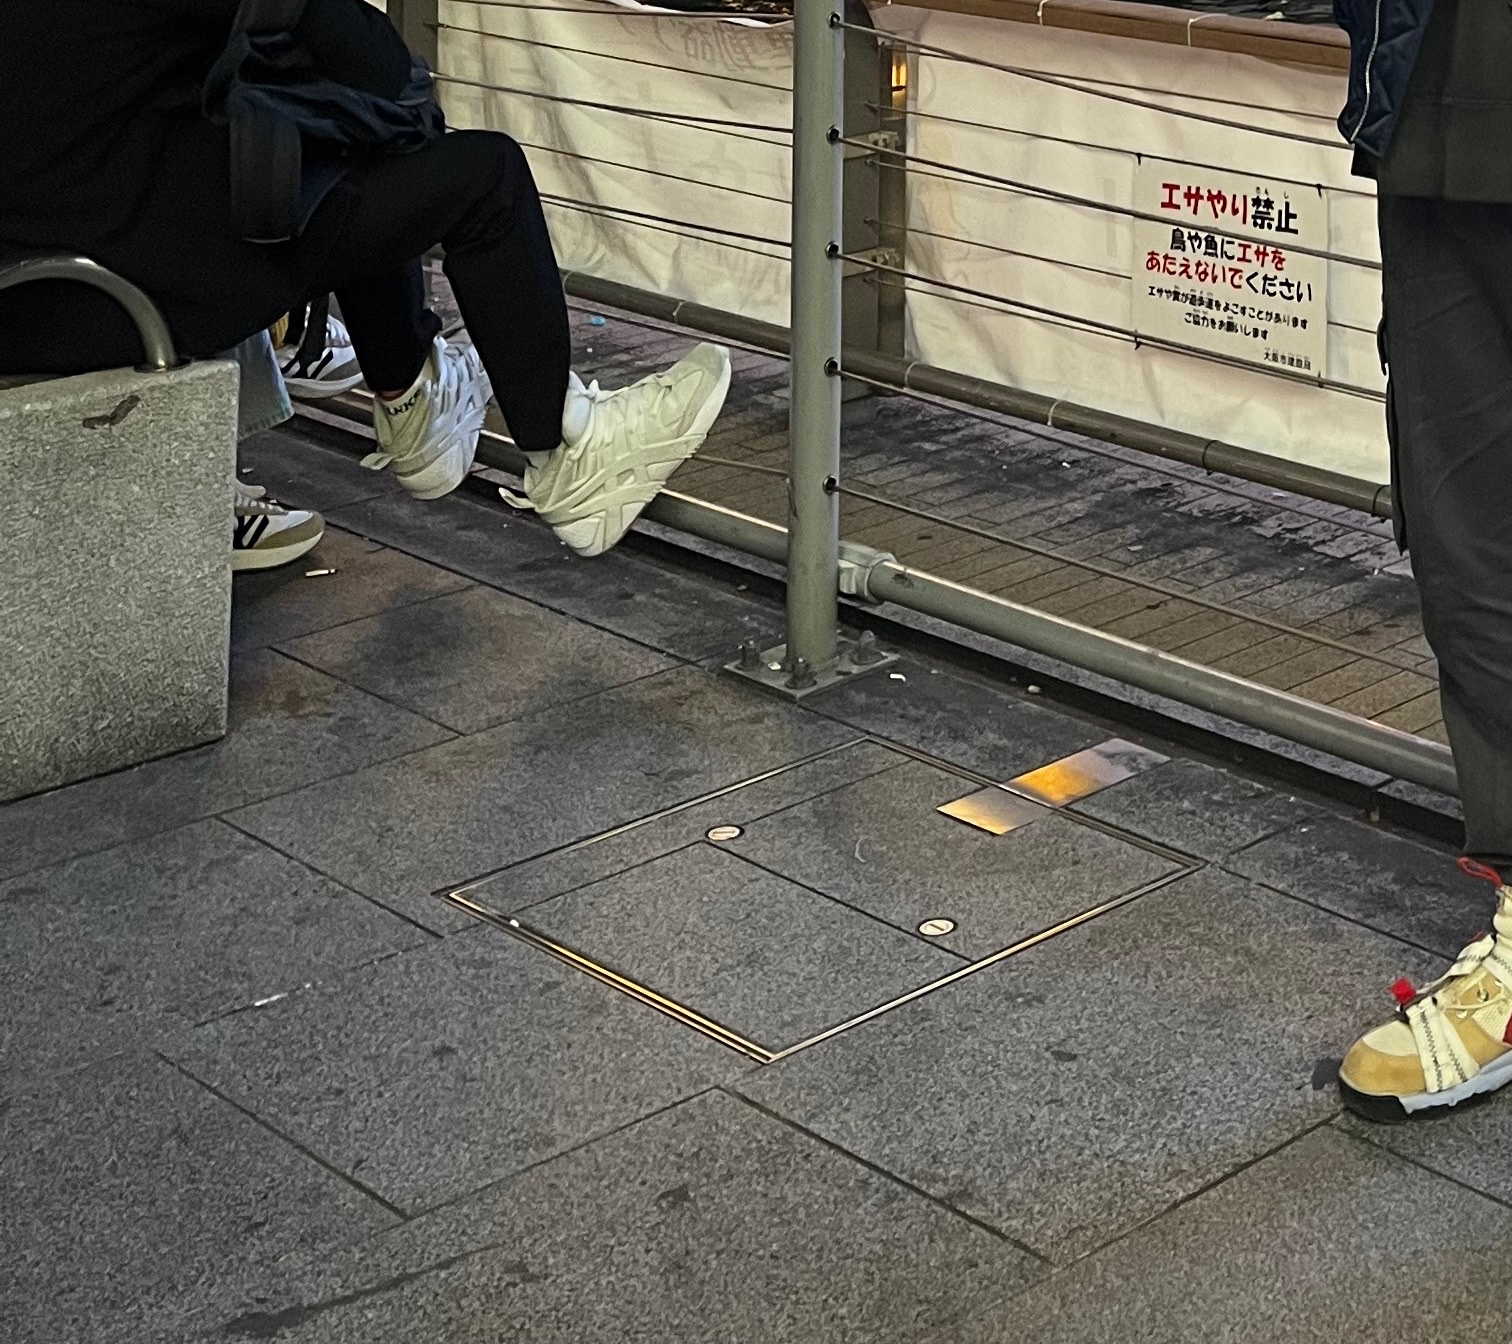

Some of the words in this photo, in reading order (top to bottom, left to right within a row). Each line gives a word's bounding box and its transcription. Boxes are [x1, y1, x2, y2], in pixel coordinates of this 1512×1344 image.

[1160, 182, 1299, 235] エサやり禁止
[1169, 227, 1286, 271] 鳥や魚にエサを
[1145, 250, 1313, 303] あたえないでください
